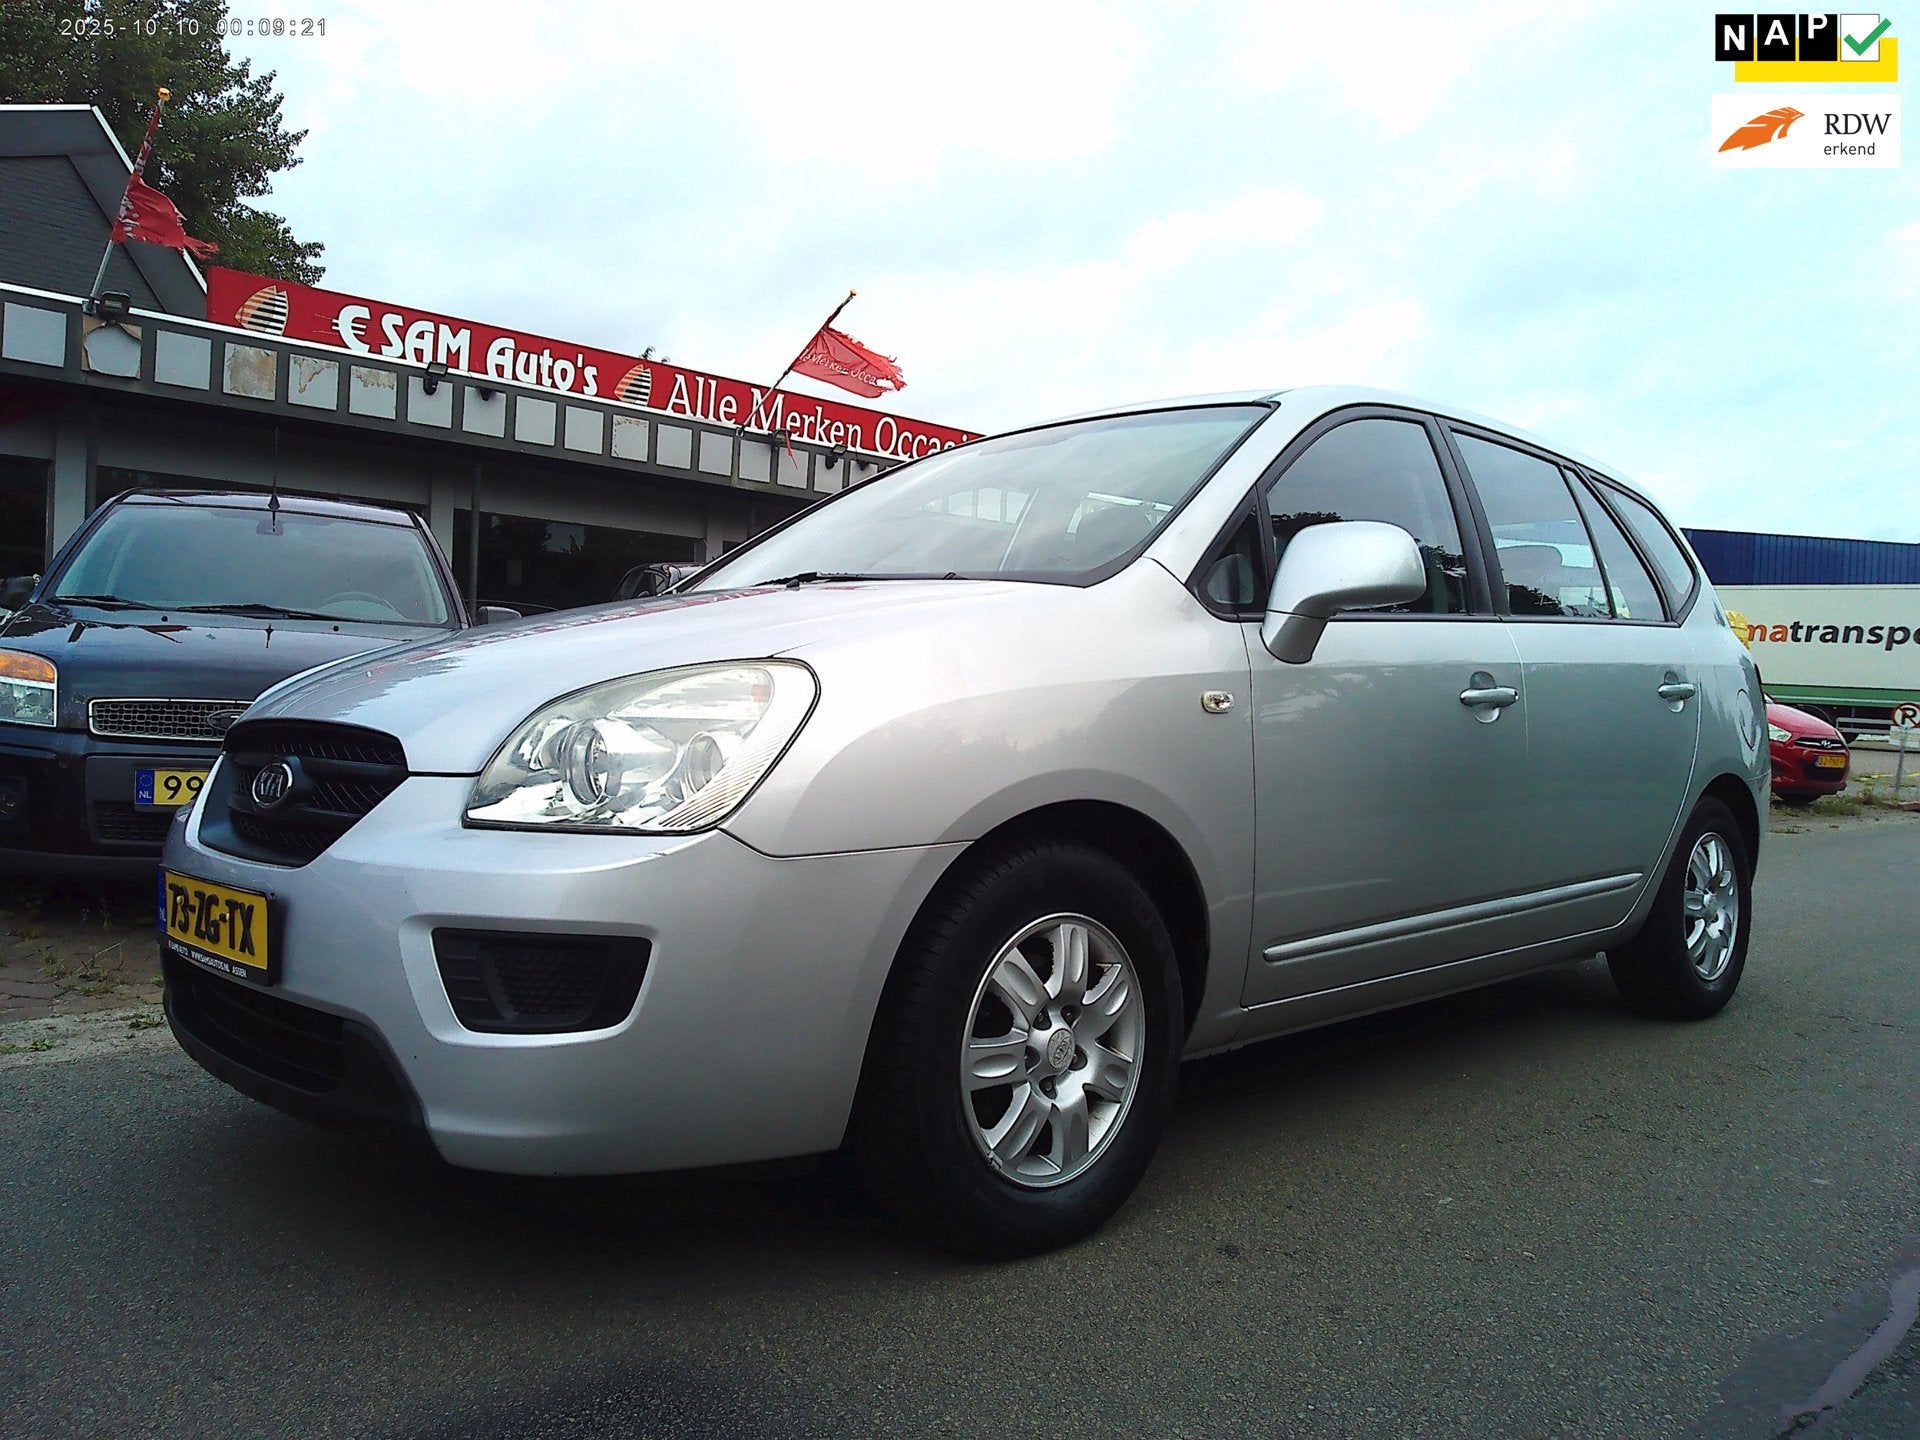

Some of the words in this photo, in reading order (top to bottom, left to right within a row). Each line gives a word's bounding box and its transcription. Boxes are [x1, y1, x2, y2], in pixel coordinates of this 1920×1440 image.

[381, 312, 471, 372] SAM
[486, 338, 598, 396] Auto's
[665, 373, 738, 424] Alle
[751, 388, 861, 451] Merken
[138, 790, 152, 799] NL
[164, 775, 205, 801] 99
